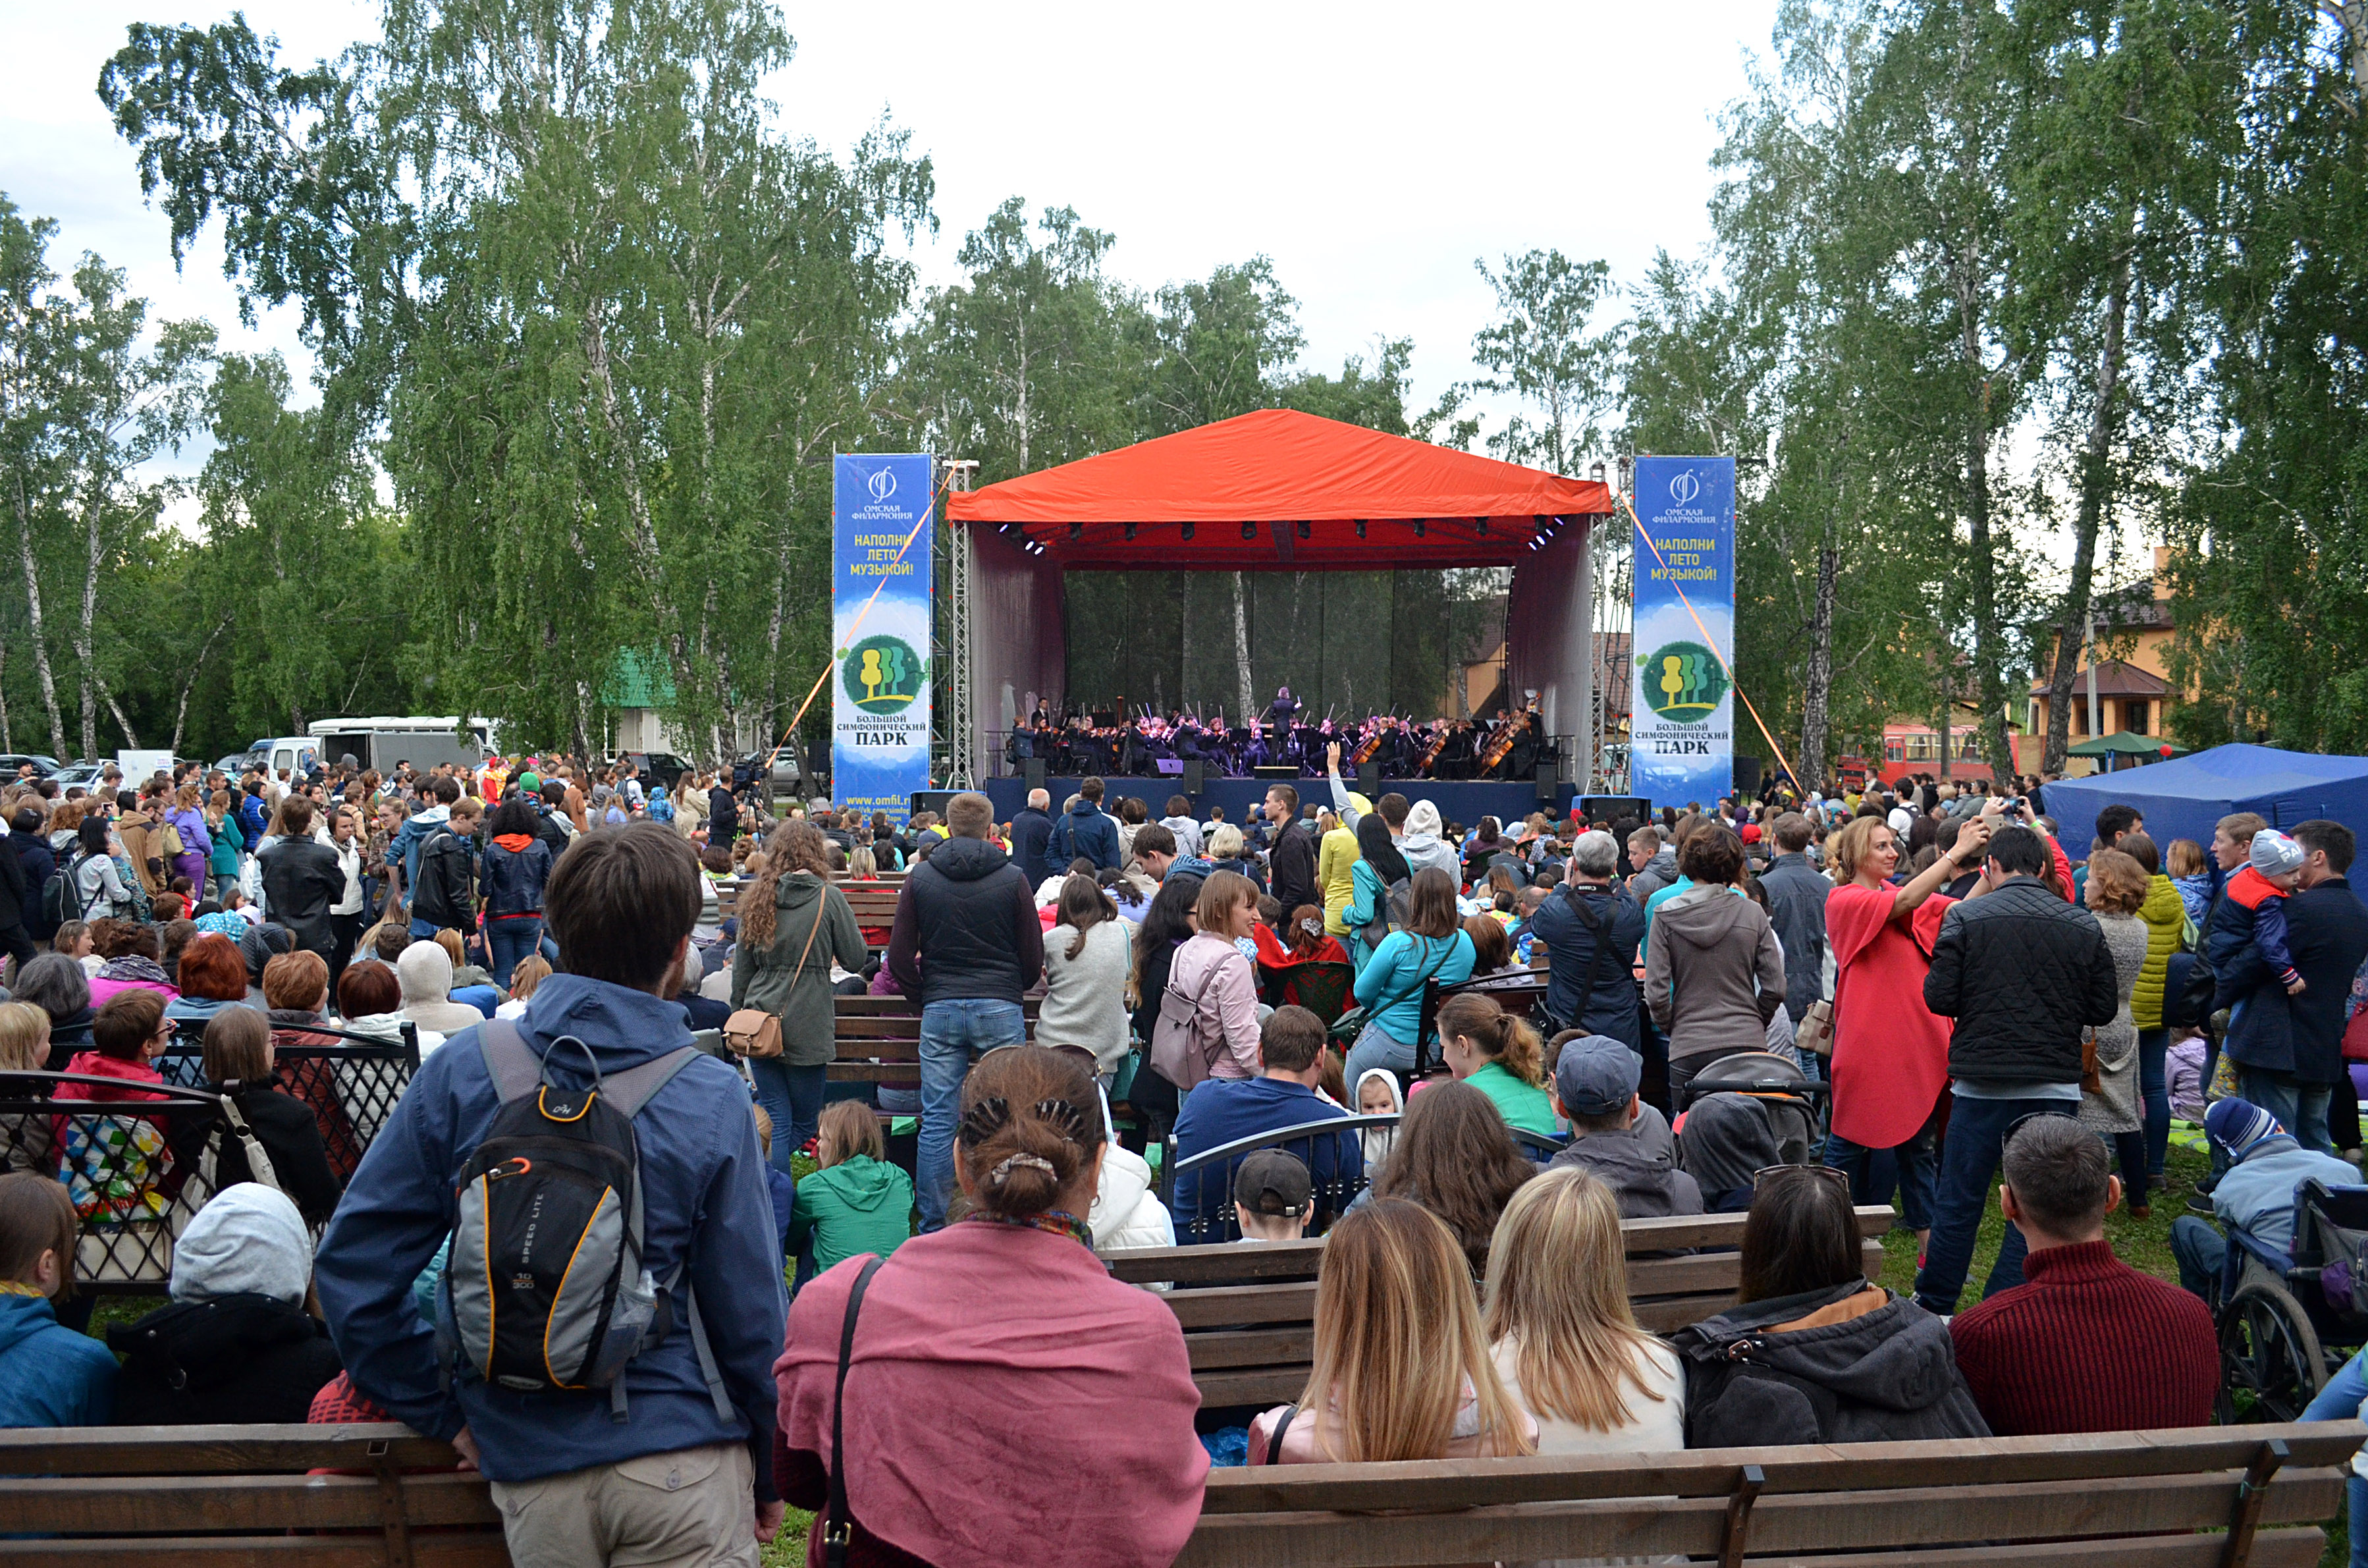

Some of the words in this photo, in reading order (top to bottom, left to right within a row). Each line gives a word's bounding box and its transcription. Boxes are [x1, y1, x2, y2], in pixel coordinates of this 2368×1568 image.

[1655, 538, 1715, 551] НАПОЛНИ
[867, 549, 898, 560] ЛЕТО
[1668, 553, 1700, 566] ЛЕТО
[850, 560, 913, 576] МУЗЫКОЙ!
[1651, 566, 1717, 581] МУЗЫКОЙ!
[857, 714, 906, 722] БОЛЬШОЙ
[1656, 722, 1708, 731] БОЛЬШОЙ
[855, 732, 908, 745] ПАРК
[1635, 731, 1729, 740] СИМФОНИЧЕСКИЙ
[1655, 741, 1709, 754] ПАРК
[846, 794, 909, 805] www.omfil.r
[522, 1224, 536, 1264] SPEED
[531, 1193, 544, 1218] LITE
